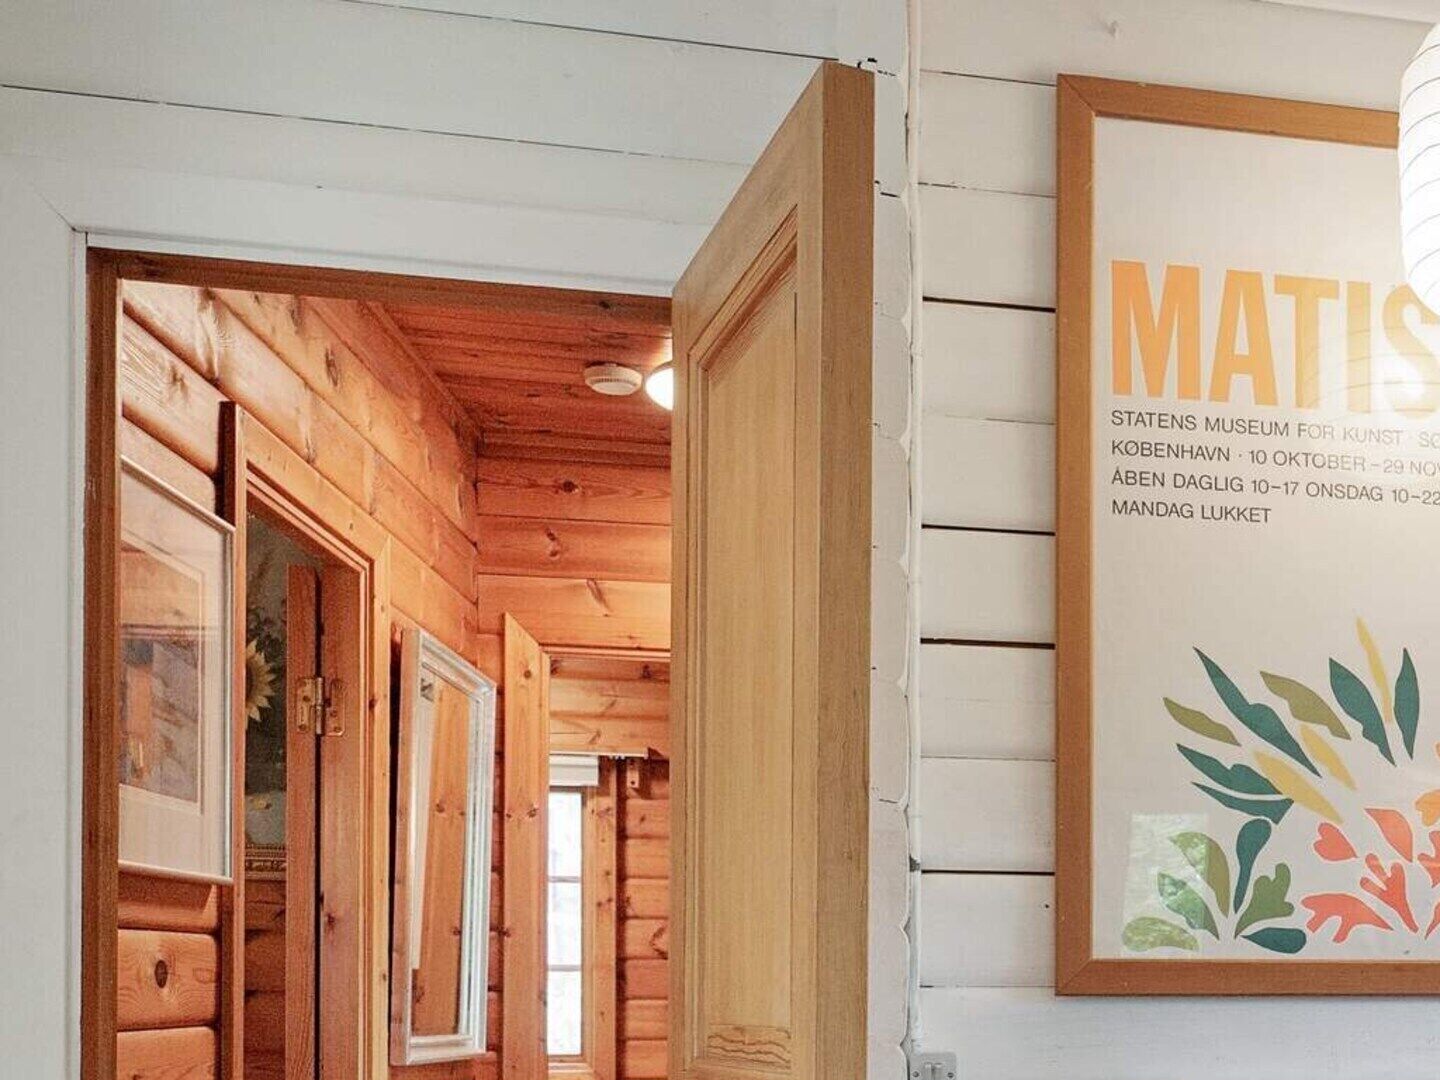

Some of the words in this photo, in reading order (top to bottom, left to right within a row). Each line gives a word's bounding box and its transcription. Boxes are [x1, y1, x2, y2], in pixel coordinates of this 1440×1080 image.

[1111, 410, 1198, 431] STATENS
[1205, 416, 1289, 437] MUSEUM
[1297, 422, 1335, 440] FOR
[1343, 426, 1404, 445] KUNST
[1111, 439, 1230, 462] KØBENHAVN
[1250, 450, 1267, 466] 10
[1273, 451, 1366, 472] OKTOBER
[1111, 466, 1166, 488] ÅBEN
[1173, 473, 1244, 493] DAGLIG
[1306, 482, 1383, 502] ONSDAG
[1111, 499, 1194, 519] MANDAG
[1201, 505, 1272, 524] LUKKET
